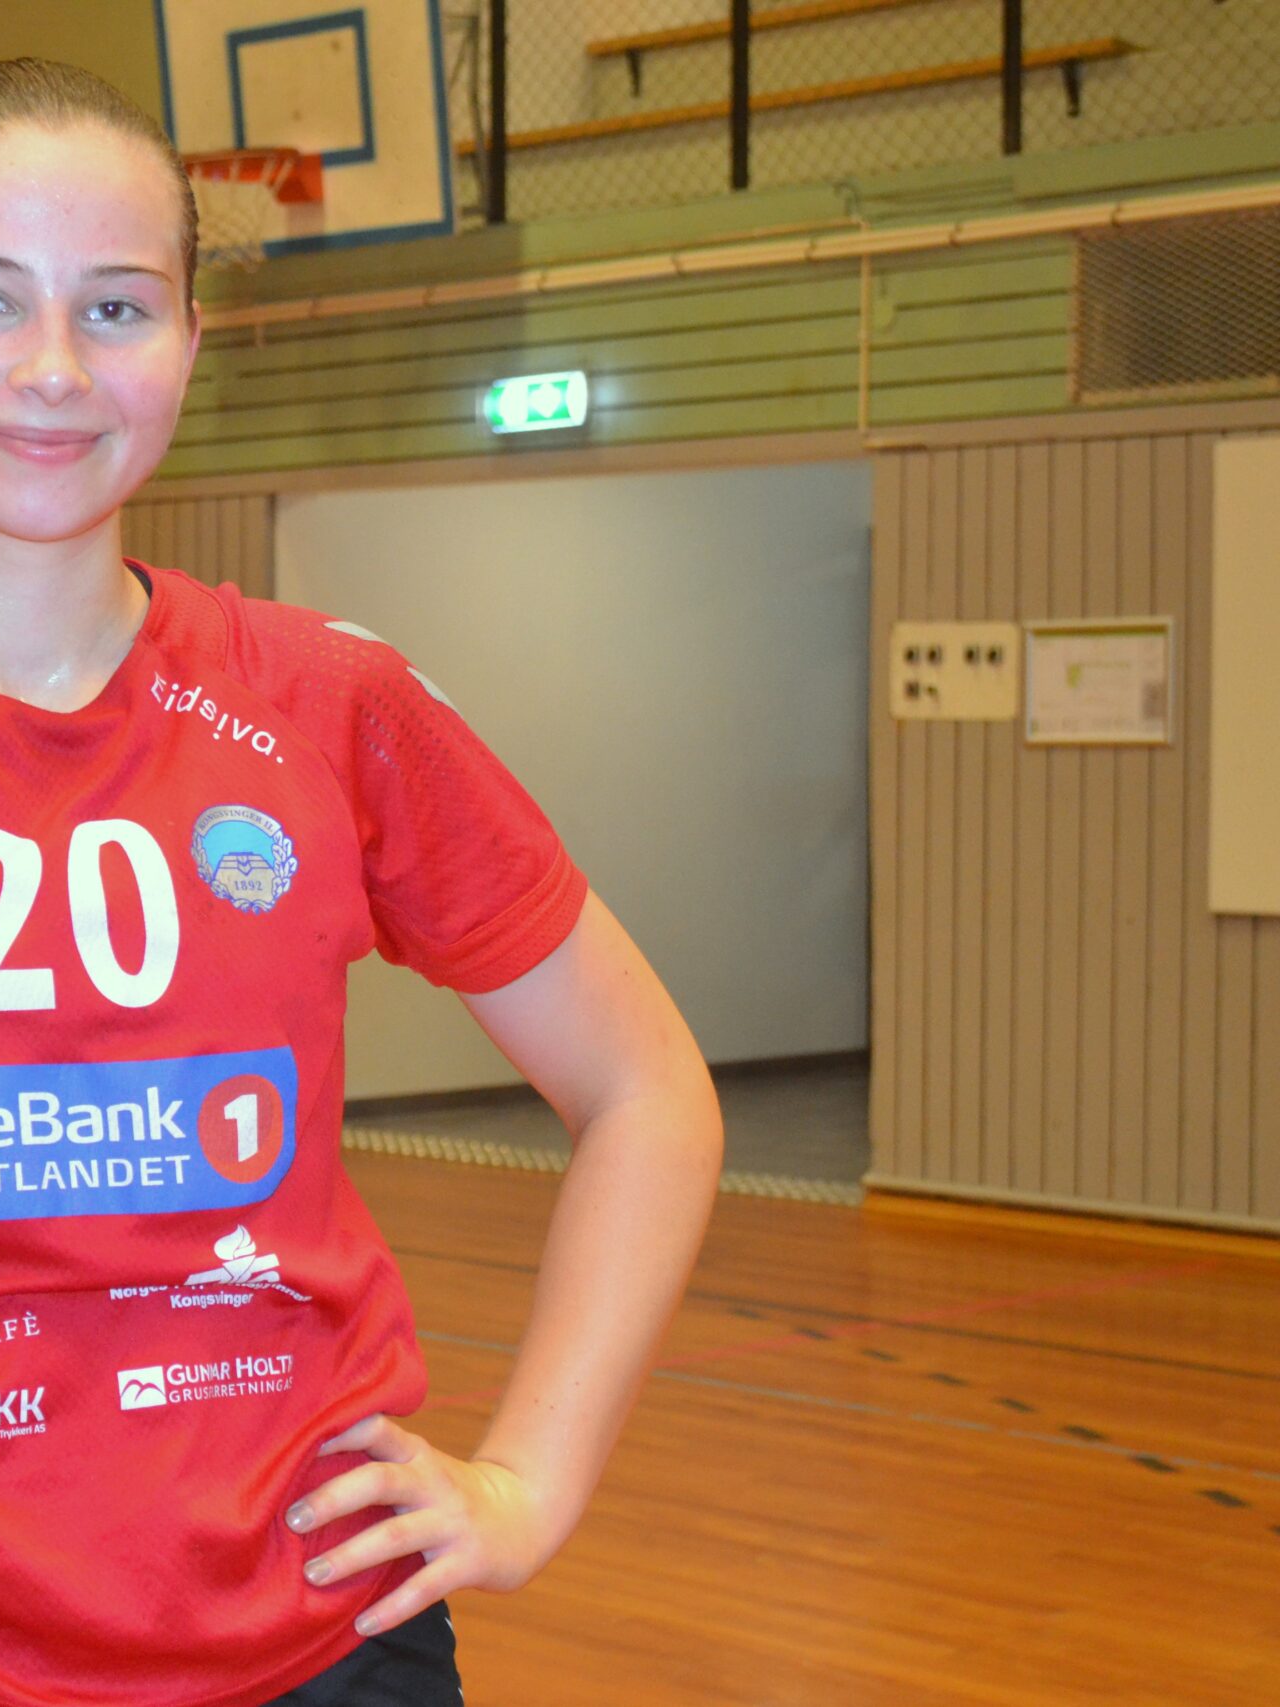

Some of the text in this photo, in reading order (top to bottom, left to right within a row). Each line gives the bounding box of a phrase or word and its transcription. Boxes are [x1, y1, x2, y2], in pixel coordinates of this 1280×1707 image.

[233, 879, 264, 892] 1892
[223, 1093, 259, 1163] 1
[170, 1291, 254, 1309] Kongsvinger
[0, 1425, 33, 1440] Trykkeri
[34, 1423, 46, 1434] AS
